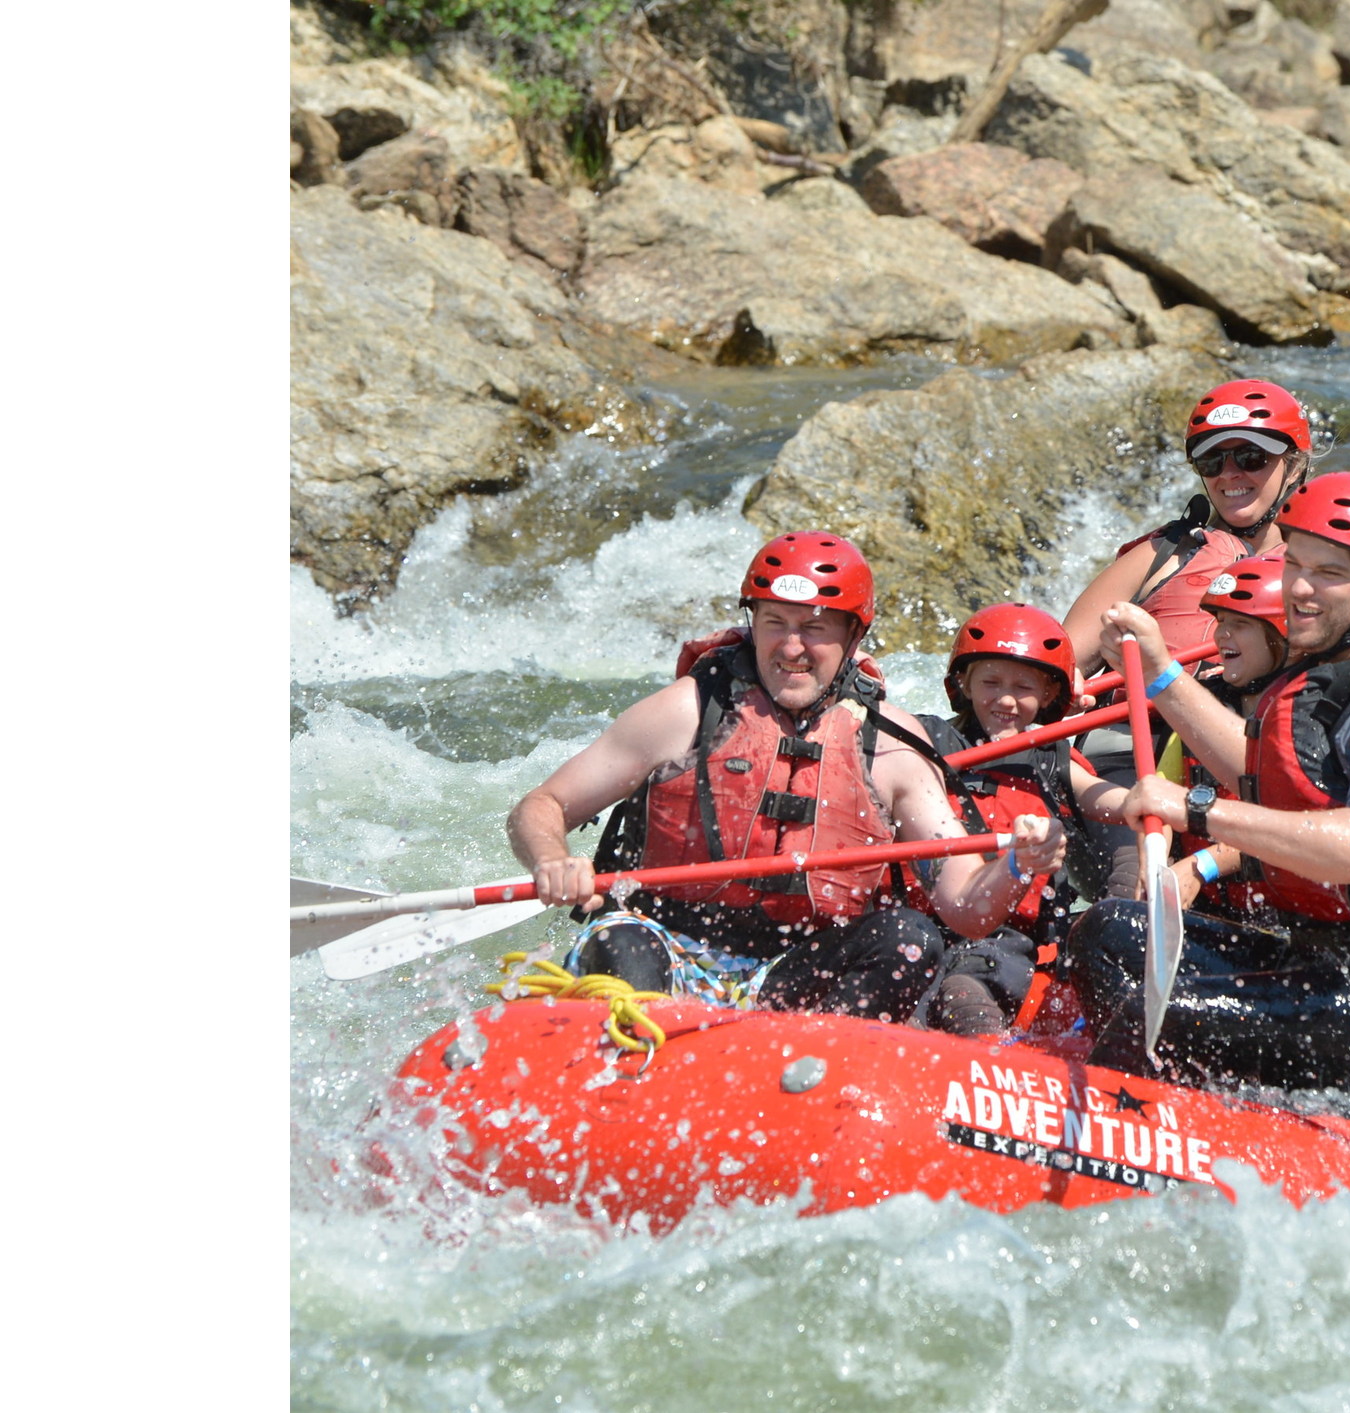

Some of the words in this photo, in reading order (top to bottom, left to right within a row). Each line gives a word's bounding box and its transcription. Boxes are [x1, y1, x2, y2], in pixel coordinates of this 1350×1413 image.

[1212, 406, 1240, 421] AAE
[777, 577, 809, 595] AAE
[945, 1080, 1214, 1181] ADVENTURE
[973, 1131, 1180, 1192] EXPEITIOS
